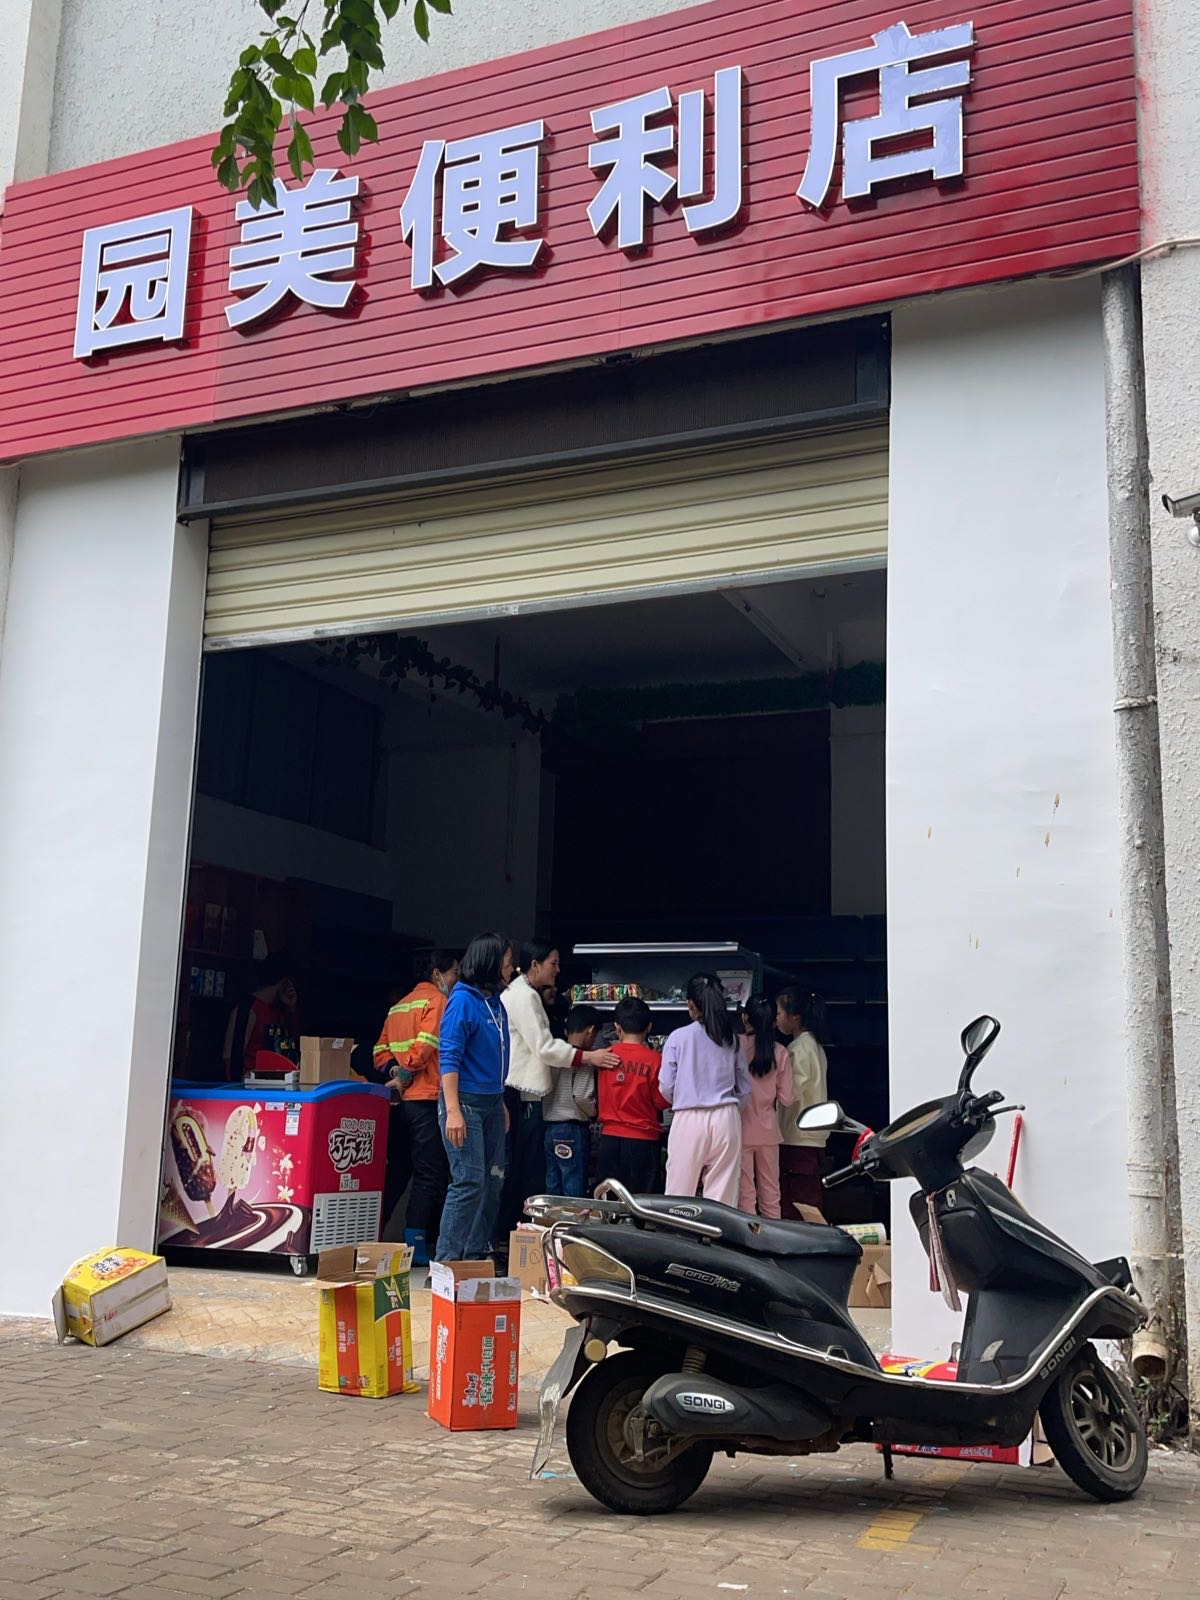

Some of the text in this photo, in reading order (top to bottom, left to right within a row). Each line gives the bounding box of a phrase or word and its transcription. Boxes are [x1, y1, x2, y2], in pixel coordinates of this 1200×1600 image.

[73, 21, 976, 360] 园美便利店
[668, 1207, 694, 1219] SONGI
[479, 1335, 496, 1406] 香辣牛肉面
[1040, 1336, 1077, 1380] SONGI
[683, 1395, 726, 1411] SONGI
